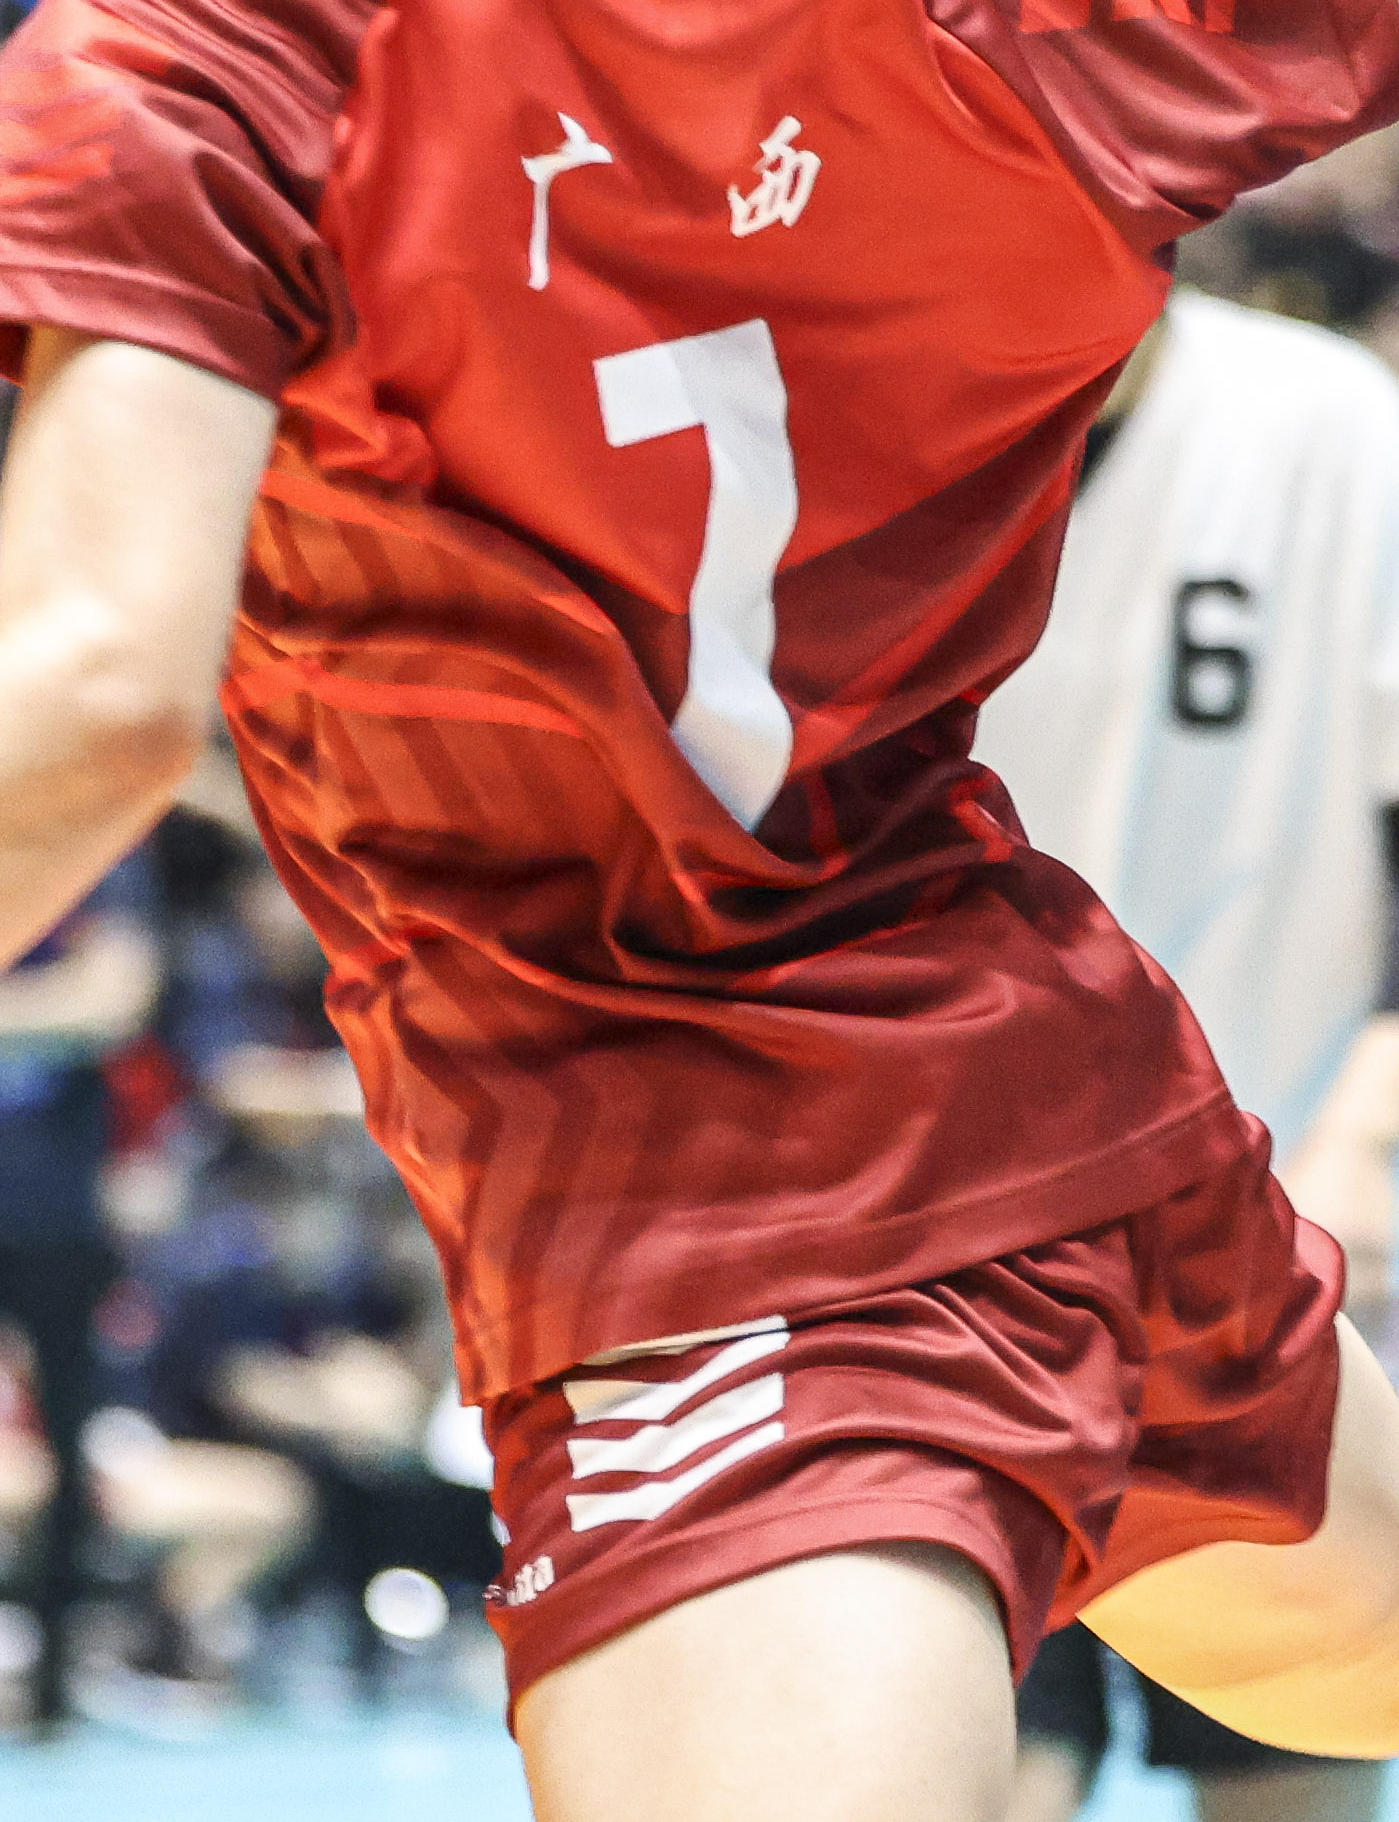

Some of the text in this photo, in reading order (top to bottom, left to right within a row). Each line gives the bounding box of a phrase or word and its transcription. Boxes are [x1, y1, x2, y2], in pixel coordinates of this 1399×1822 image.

[522, 112, 822, 291] 广西
[593, 318, 799, 832] 7
[1171, 577, 1256, 731] 6
